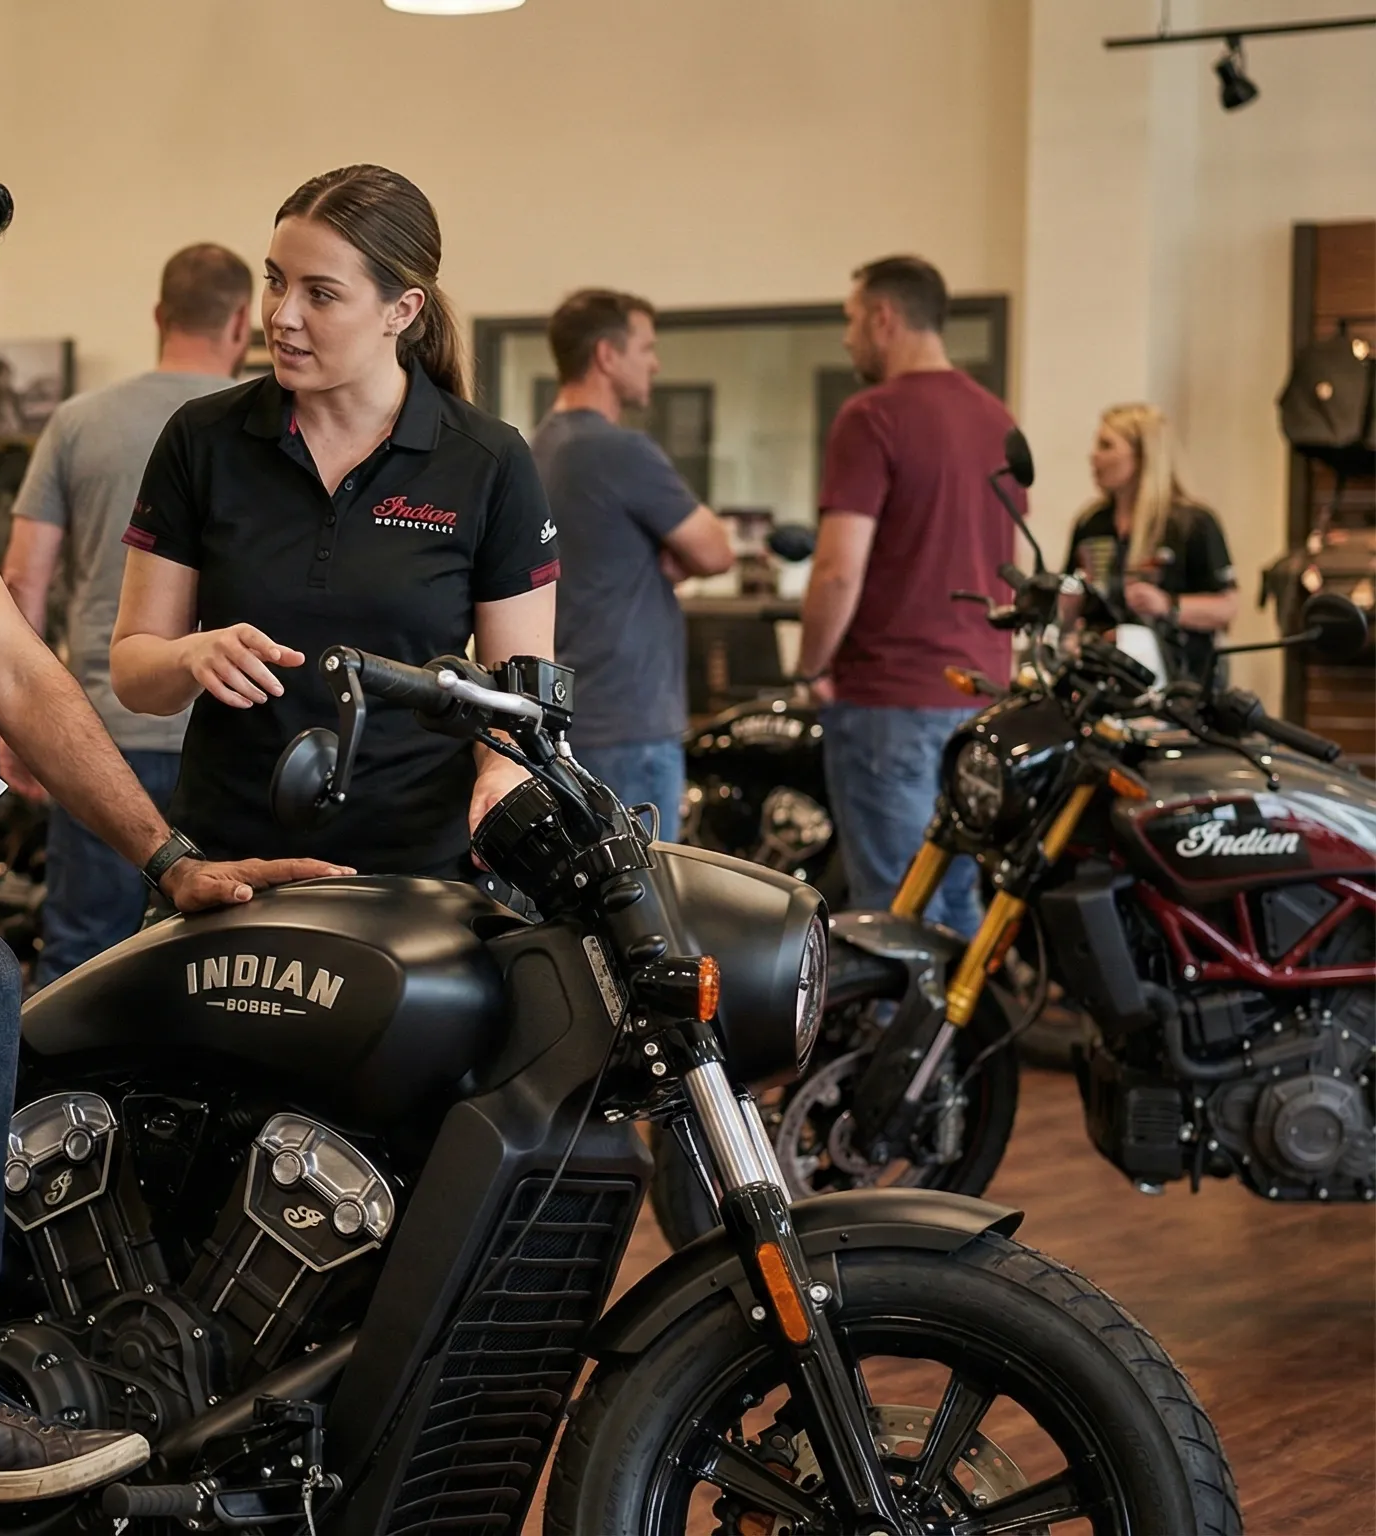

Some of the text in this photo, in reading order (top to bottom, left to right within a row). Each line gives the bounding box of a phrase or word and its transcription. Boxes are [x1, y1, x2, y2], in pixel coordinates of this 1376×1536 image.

[372, 496, 457, 526] Indian
[1176, 820, 1300, 858] Indian
[186, 954, 345, 1010] INDIAN
